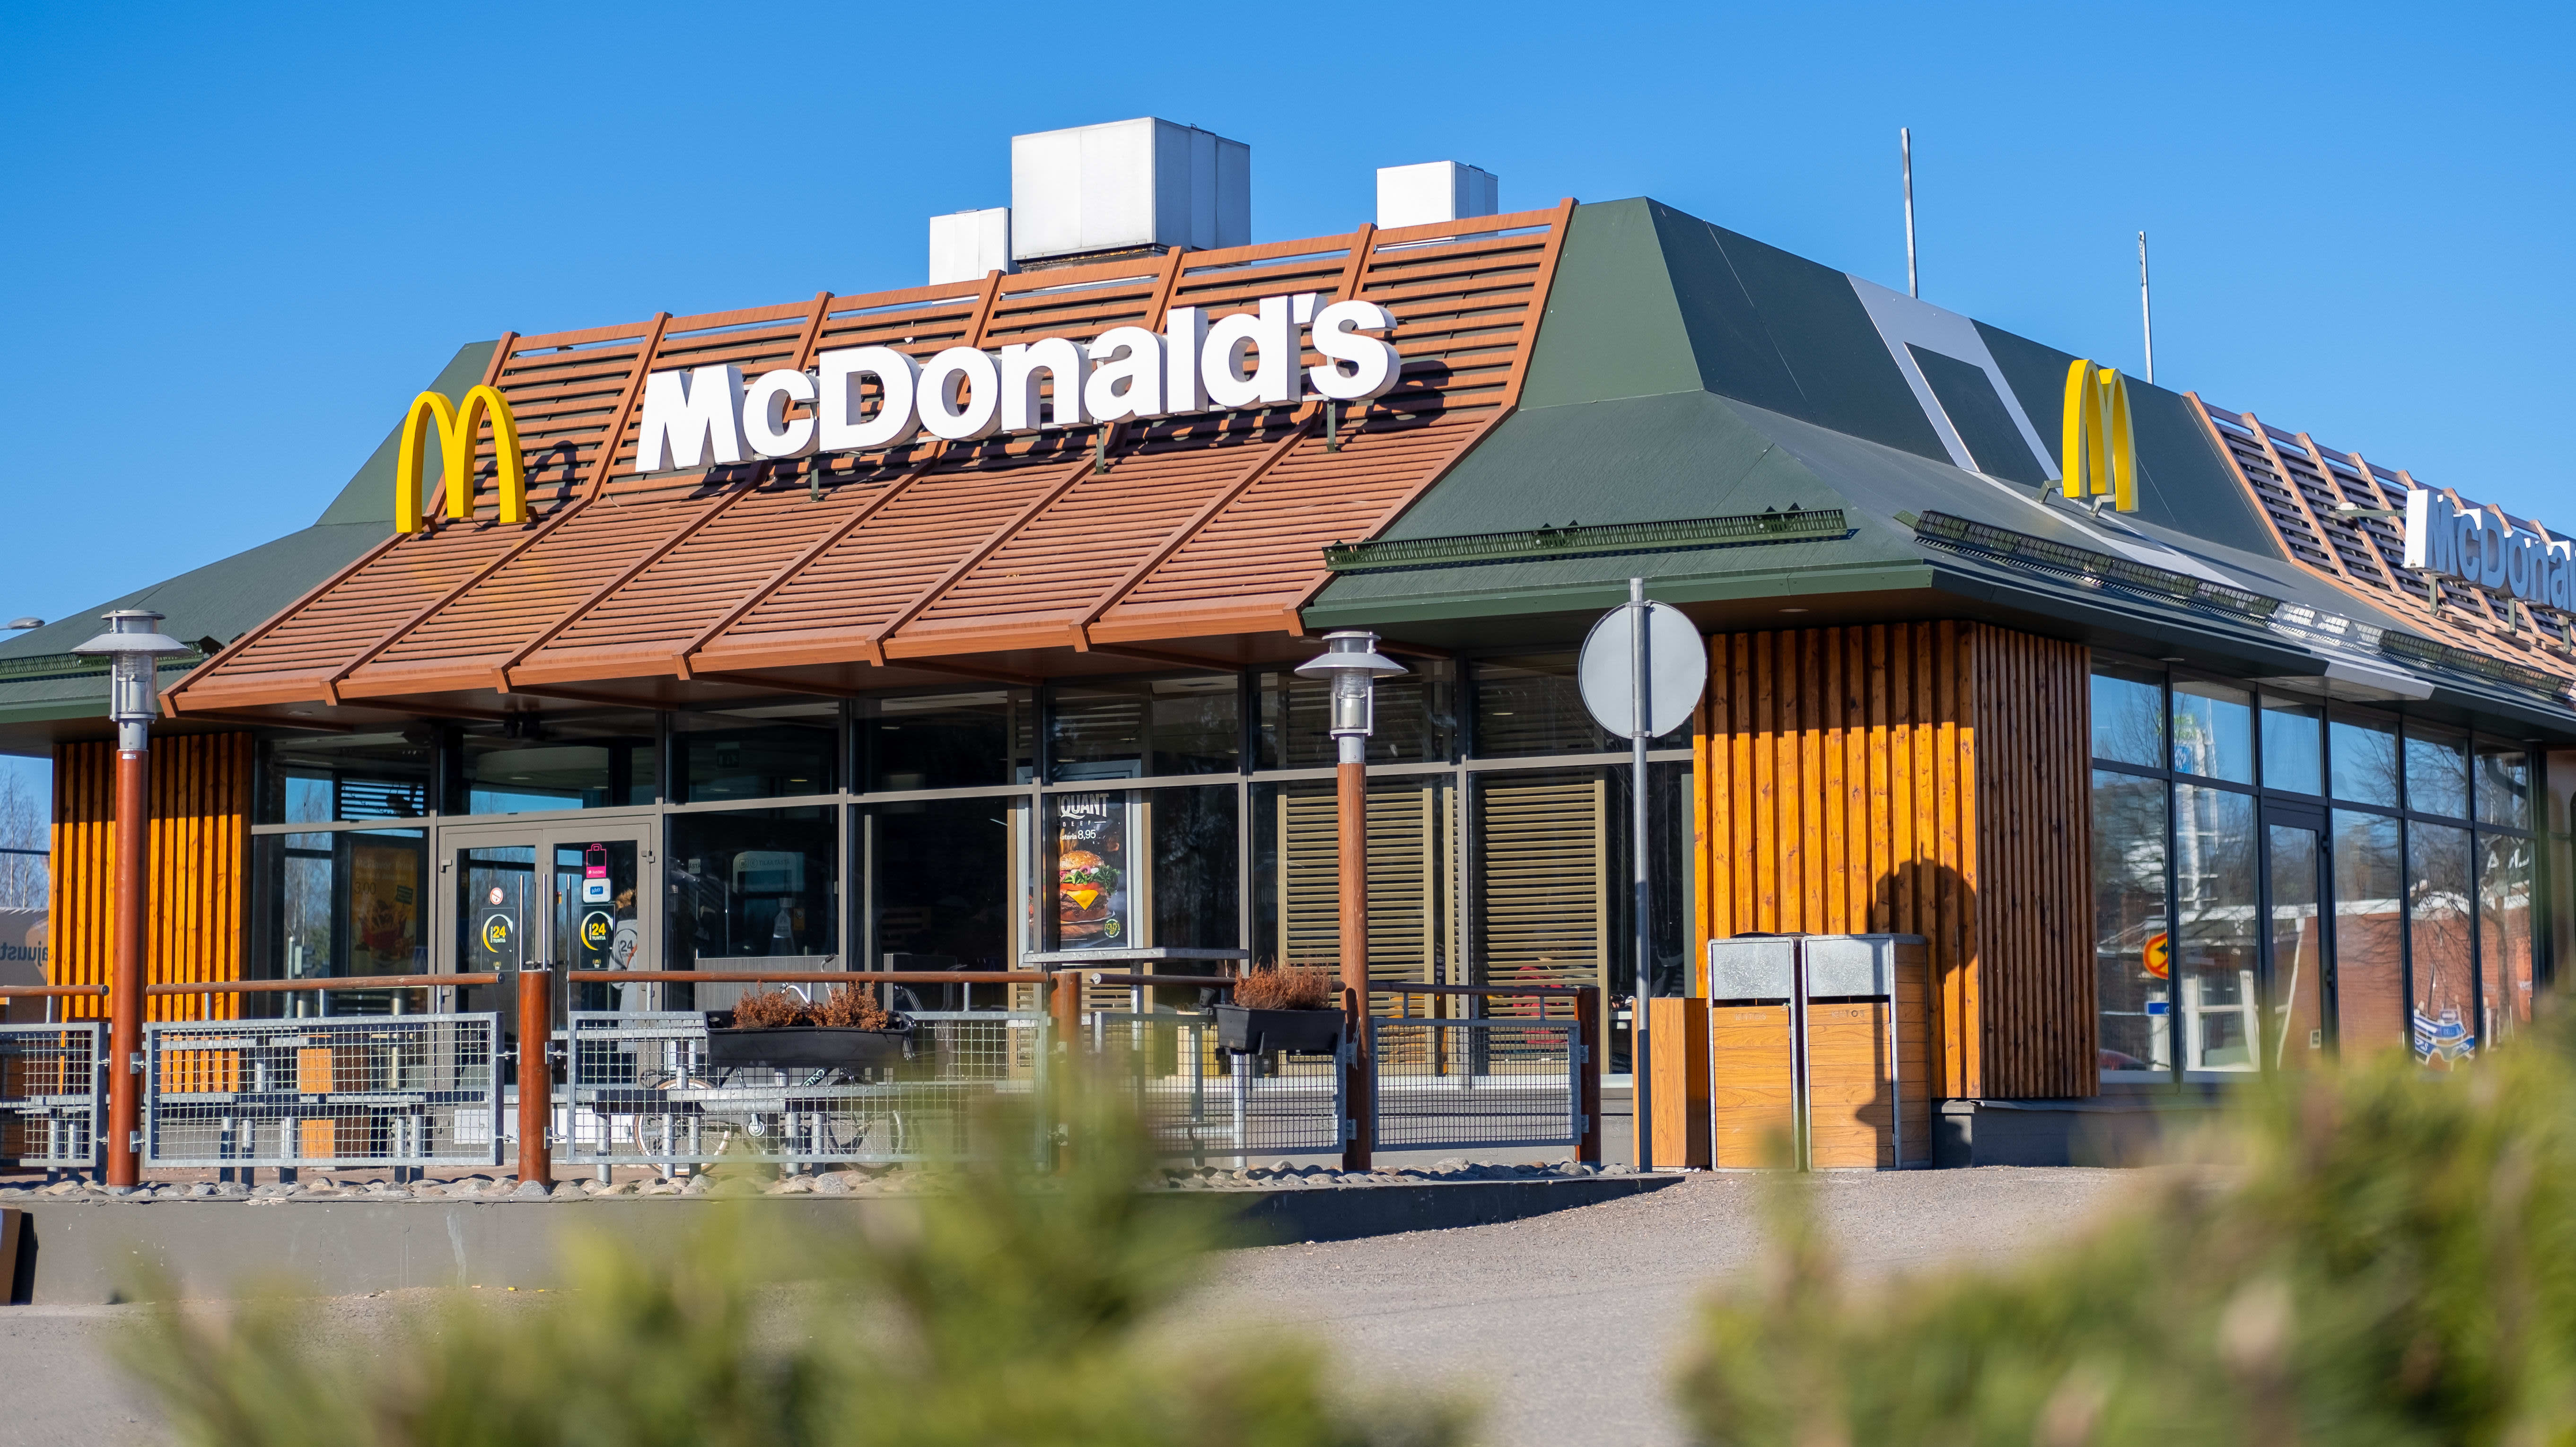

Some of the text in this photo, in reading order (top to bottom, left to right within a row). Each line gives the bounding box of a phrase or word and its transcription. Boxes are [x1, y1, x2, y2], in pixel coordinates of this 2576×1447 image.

[635, 292, 1400, 472] McDonald's
[1078, 829, 1096, 841] 8,95
[493, 925, 506, 938] 24
[592, 923, 606, 935] 24
